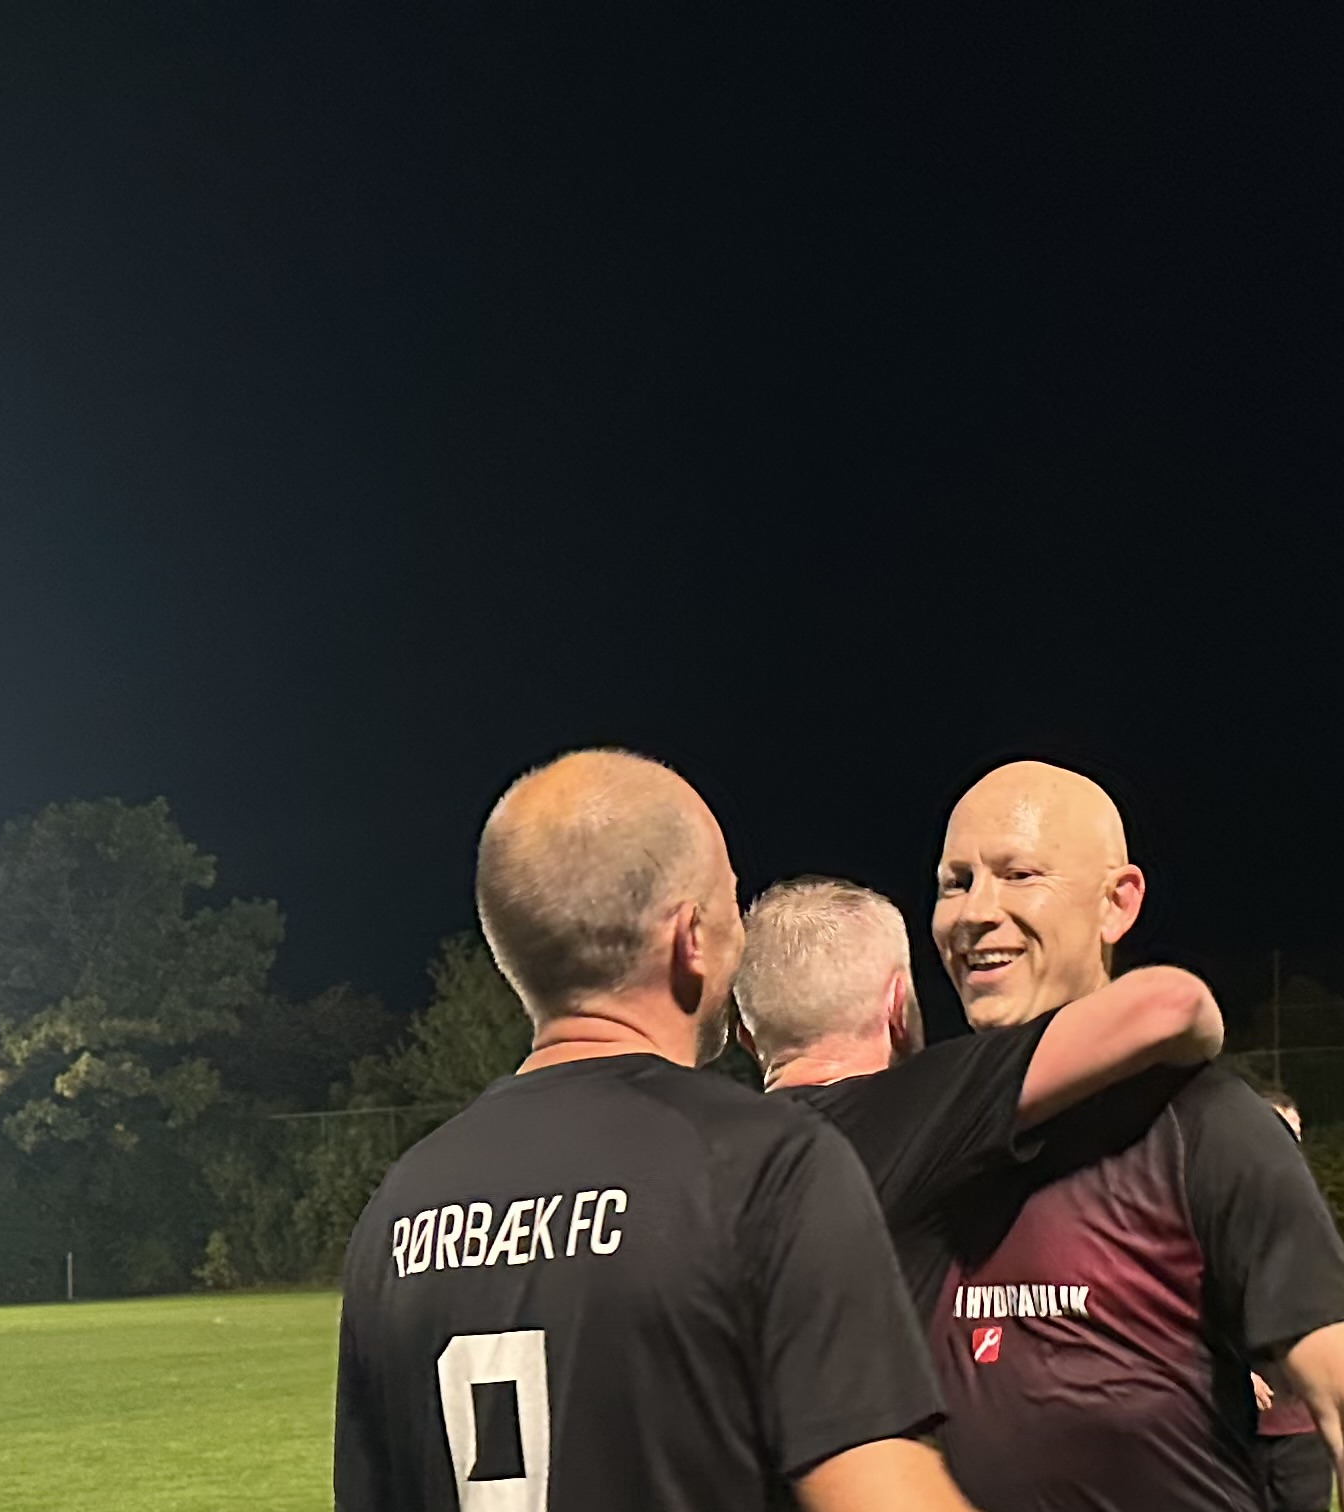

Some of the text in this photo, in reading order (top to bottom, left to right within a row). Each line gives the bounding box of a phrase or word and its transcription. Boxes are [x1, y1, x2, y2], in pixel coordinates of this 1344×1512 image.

[393, 1189, 628, 1278] RØRBÆK FC
[966, 1284, 1089, 1318] HYDRAULIK
